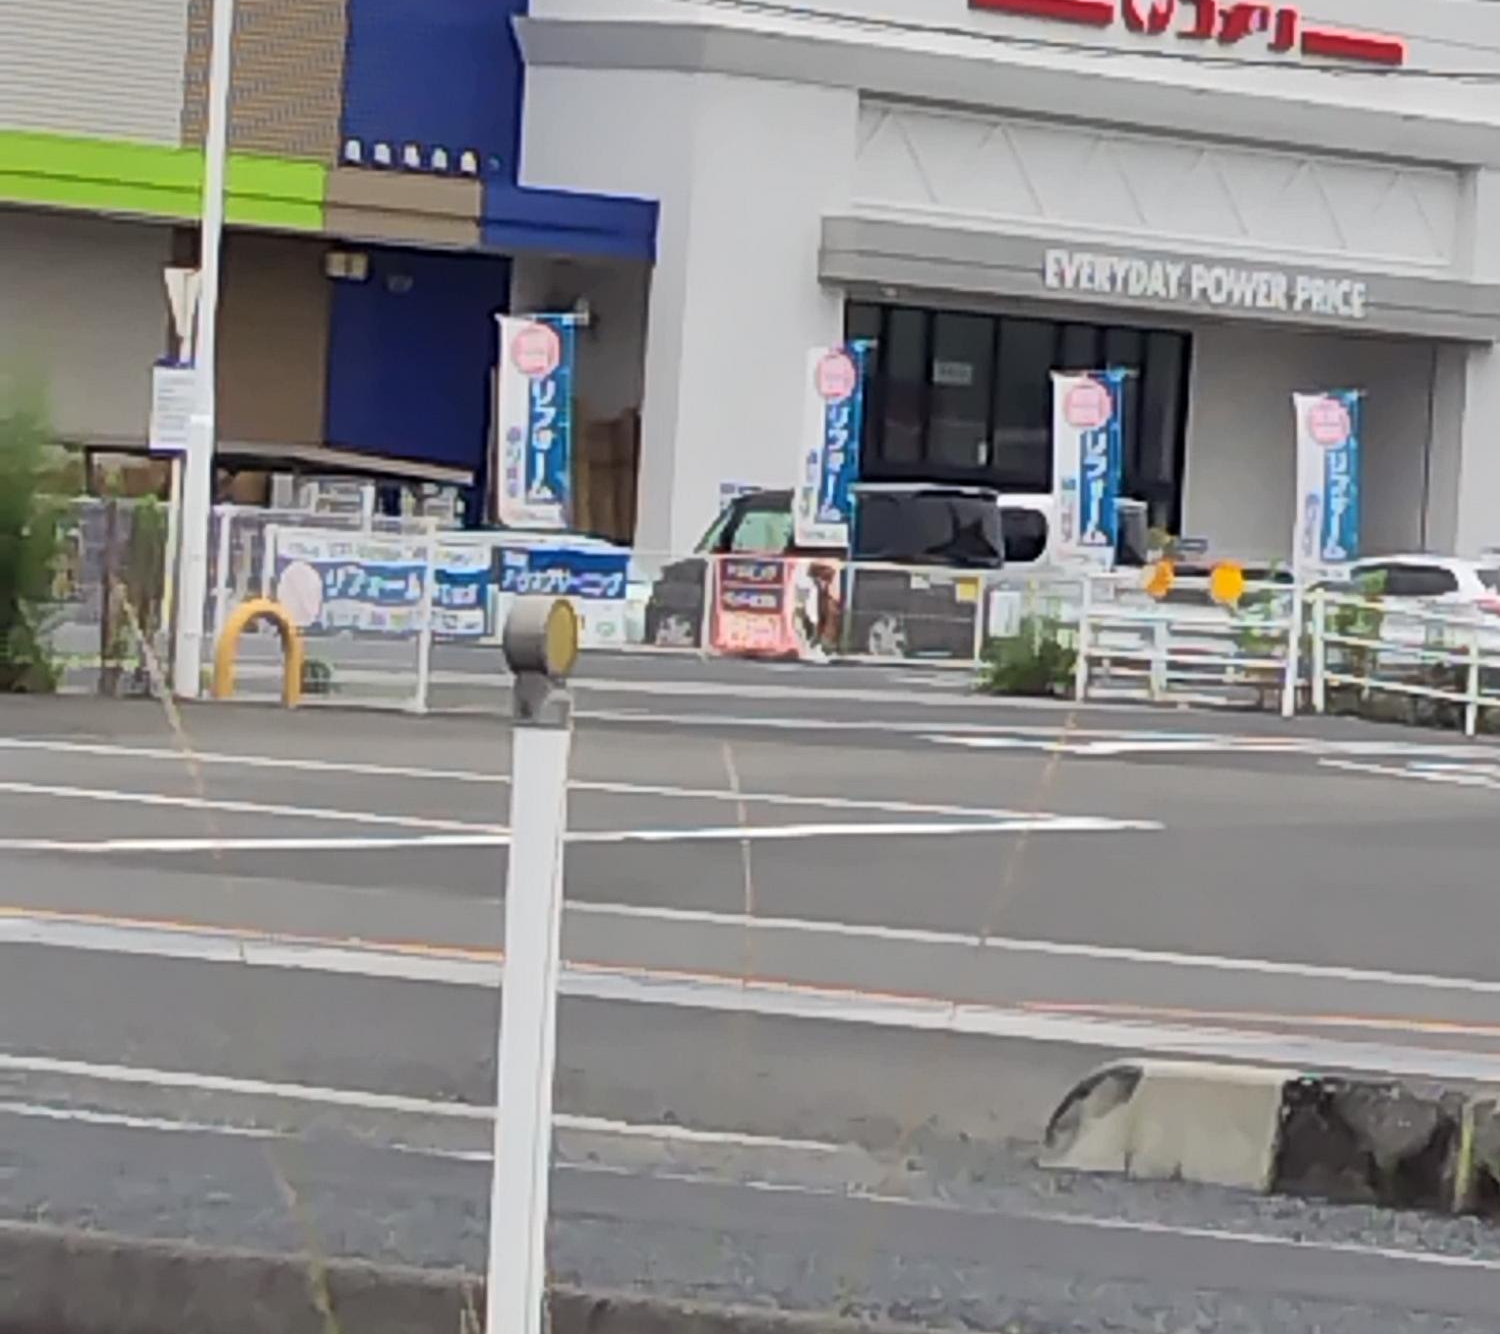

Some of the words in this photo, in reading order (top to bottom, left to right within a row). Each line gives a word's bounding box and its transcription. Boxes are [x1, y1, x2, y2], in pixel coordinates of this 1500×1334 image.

[1044, 248, 1186, 300] EVERYDAY
[1190, 264, 1288, 312] POWER
[1292, 274, 1367, 319] PRICE
